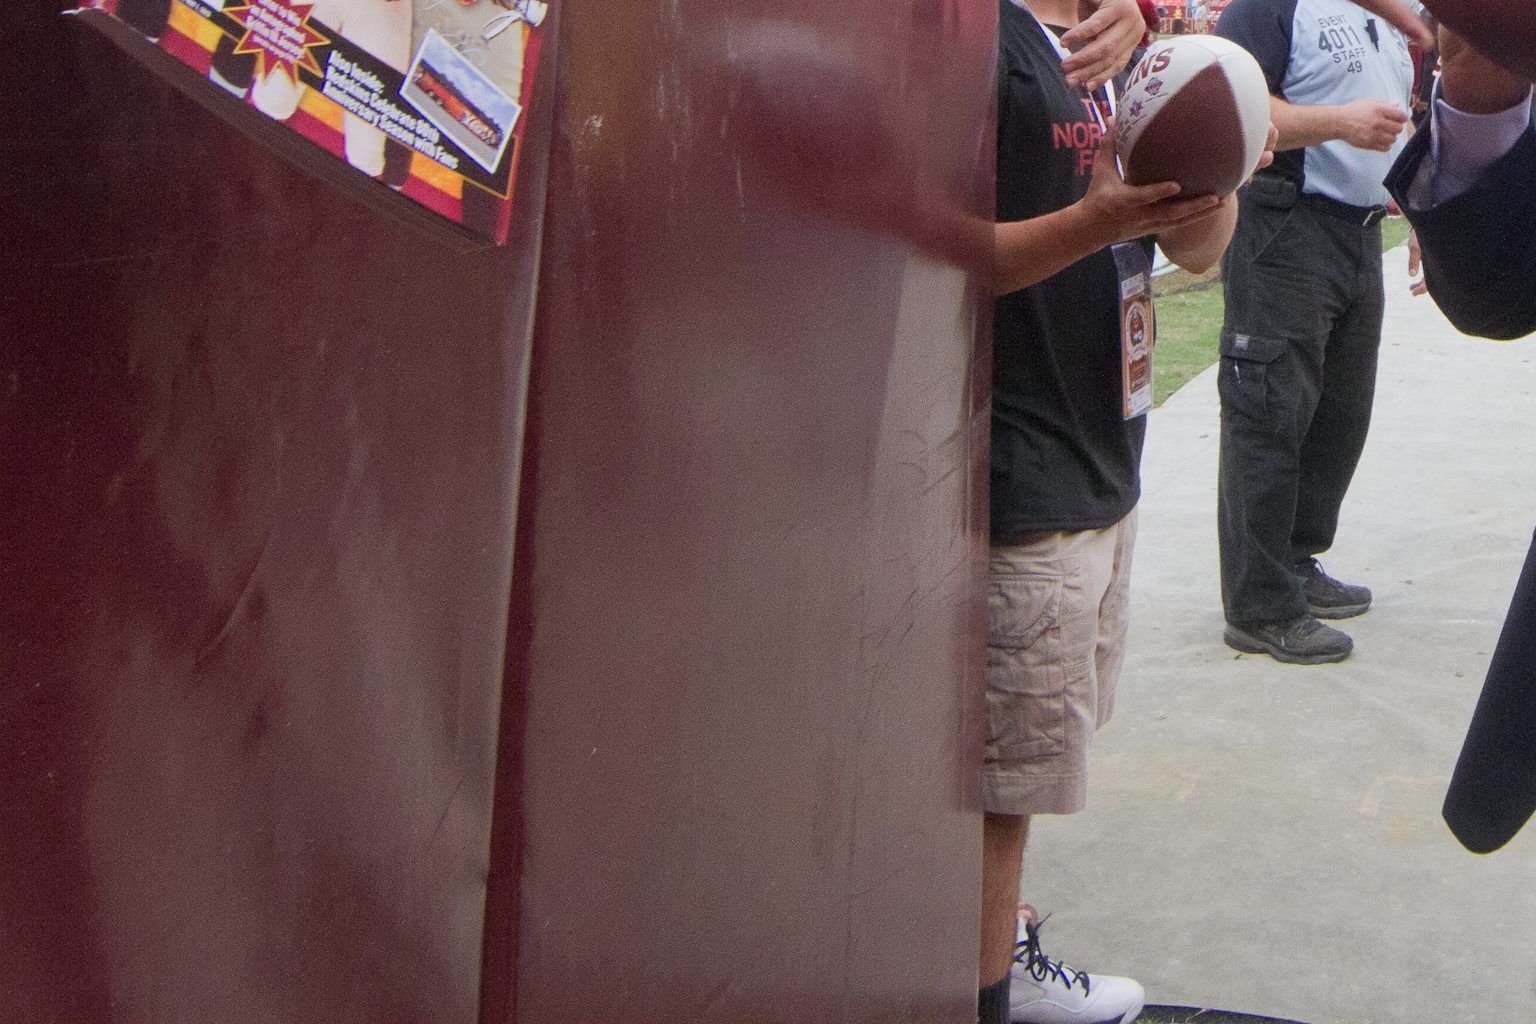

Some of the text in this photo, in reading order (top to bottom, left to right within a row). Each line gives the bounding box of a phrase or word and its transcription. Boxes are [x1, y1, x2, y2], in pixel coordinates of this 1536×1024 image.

[1318, 15, 1347, 29] EVENT
[1318, 25, 1361, 53] 4011
[1333, 47, 1366, 64] STAFF
[1347, 60, 1362, 74] 49
[326, 65, 371, 106] Redskins
[369, 92, 417, 132] Celebrate
